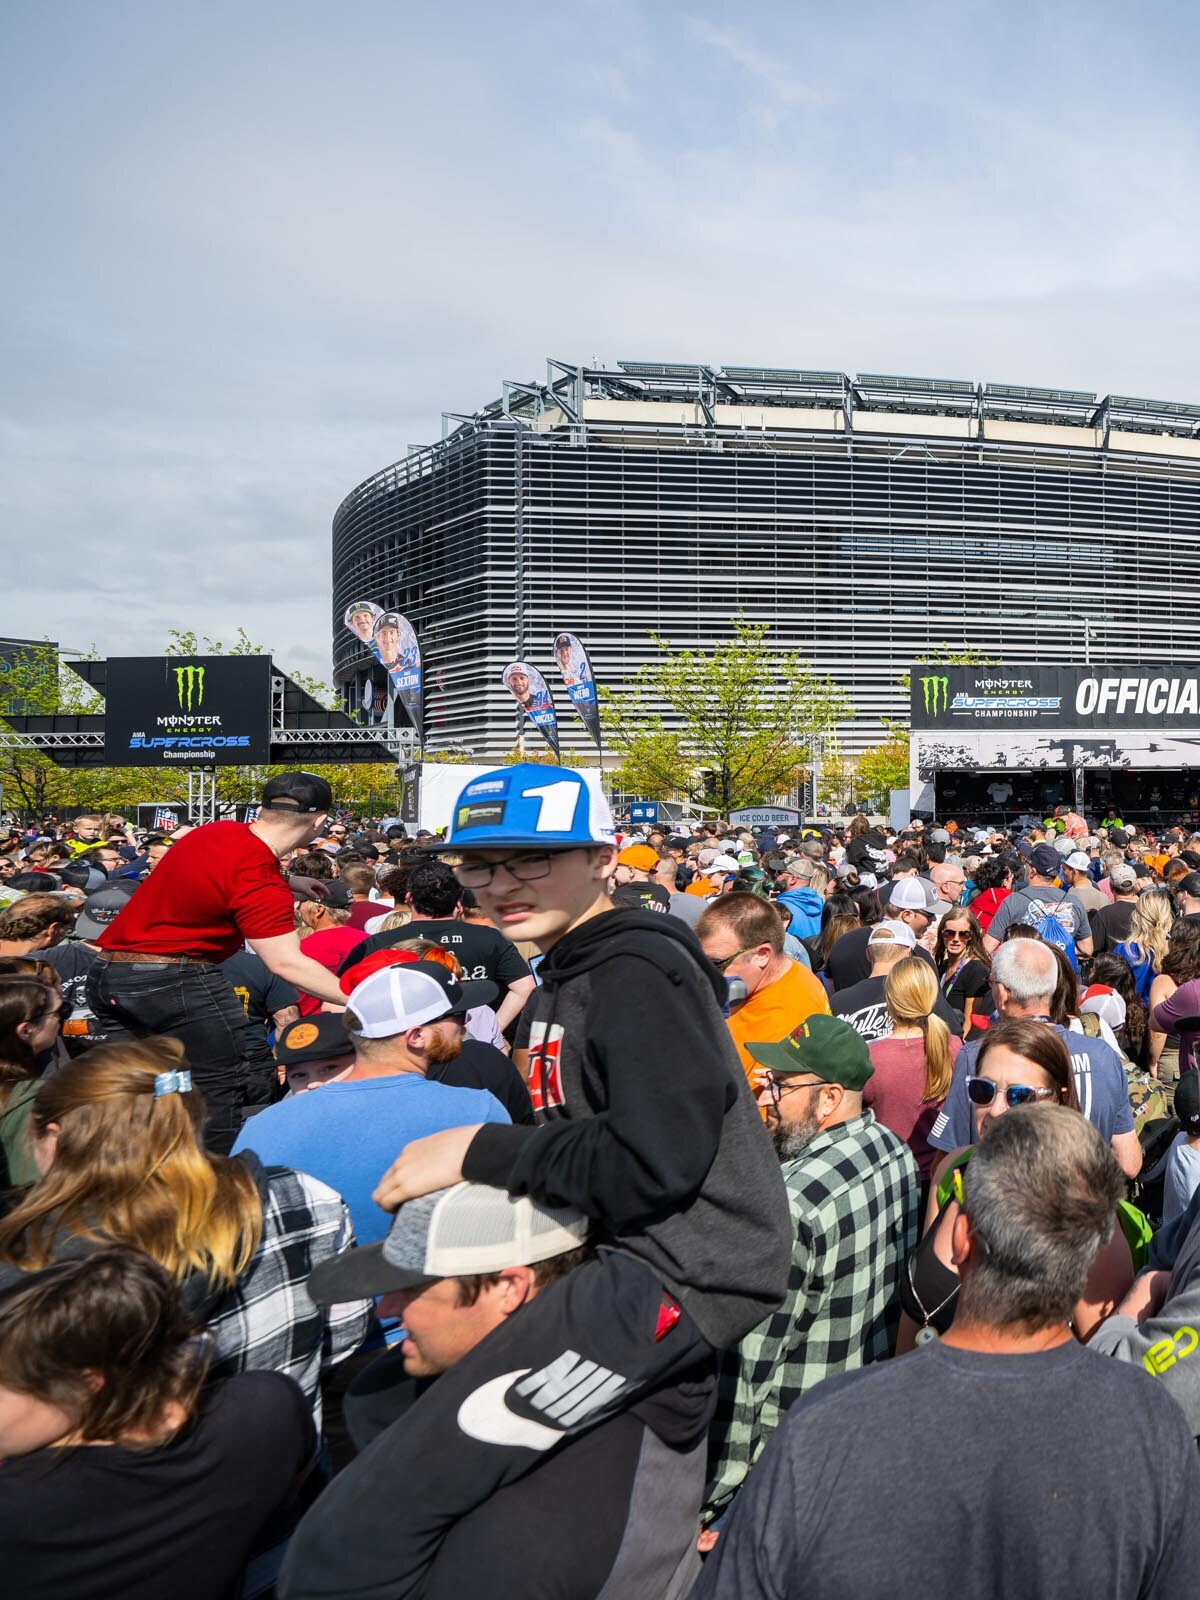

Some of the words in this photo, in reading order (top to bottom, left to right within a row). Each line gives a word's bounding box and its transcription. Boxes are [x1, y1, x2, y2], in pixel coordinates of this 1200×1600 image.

[396, 674, 419, 688] SEXTON
[975, 678, 1033, 690] MONSTER
[951, 697, 1062, 709] SUPERCROSS
[975, 709, 1038, 718] CHAMPIONSHIP
[157, 715, 222, 727] MONSTER
[128, 736, 251, 748] SUPERCROSS
[163, 750, 216, 759] Championship
[522, 780, 581, 832] 1
[739, 814, 750, 822] ICE
[752, 814, 769, 822] COLD
[771, 814, 789, 822] BEER
[440, 934, 463, 943] am
